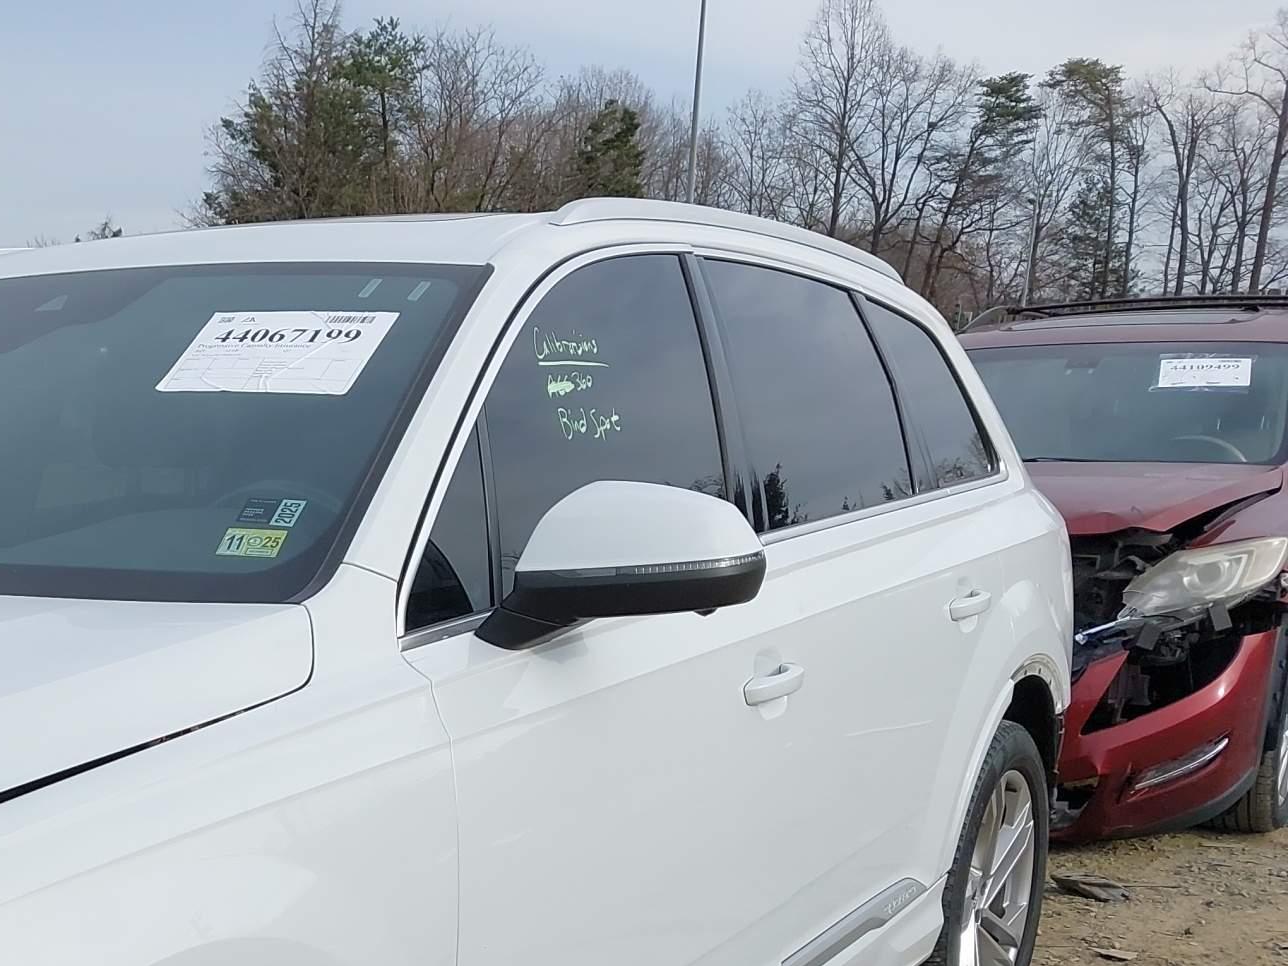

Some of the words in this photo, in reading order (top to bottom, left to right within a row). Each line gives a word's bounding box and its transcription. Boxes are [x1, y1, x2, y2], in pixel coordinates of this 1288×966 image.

[214, 327, 362, 344] 44067199
[590, 407, 621, 441] Spot
[275, 501, 301, 524] 2025
[225, 534, 245, 551] 11
[261, 535, 282, 549] 25
